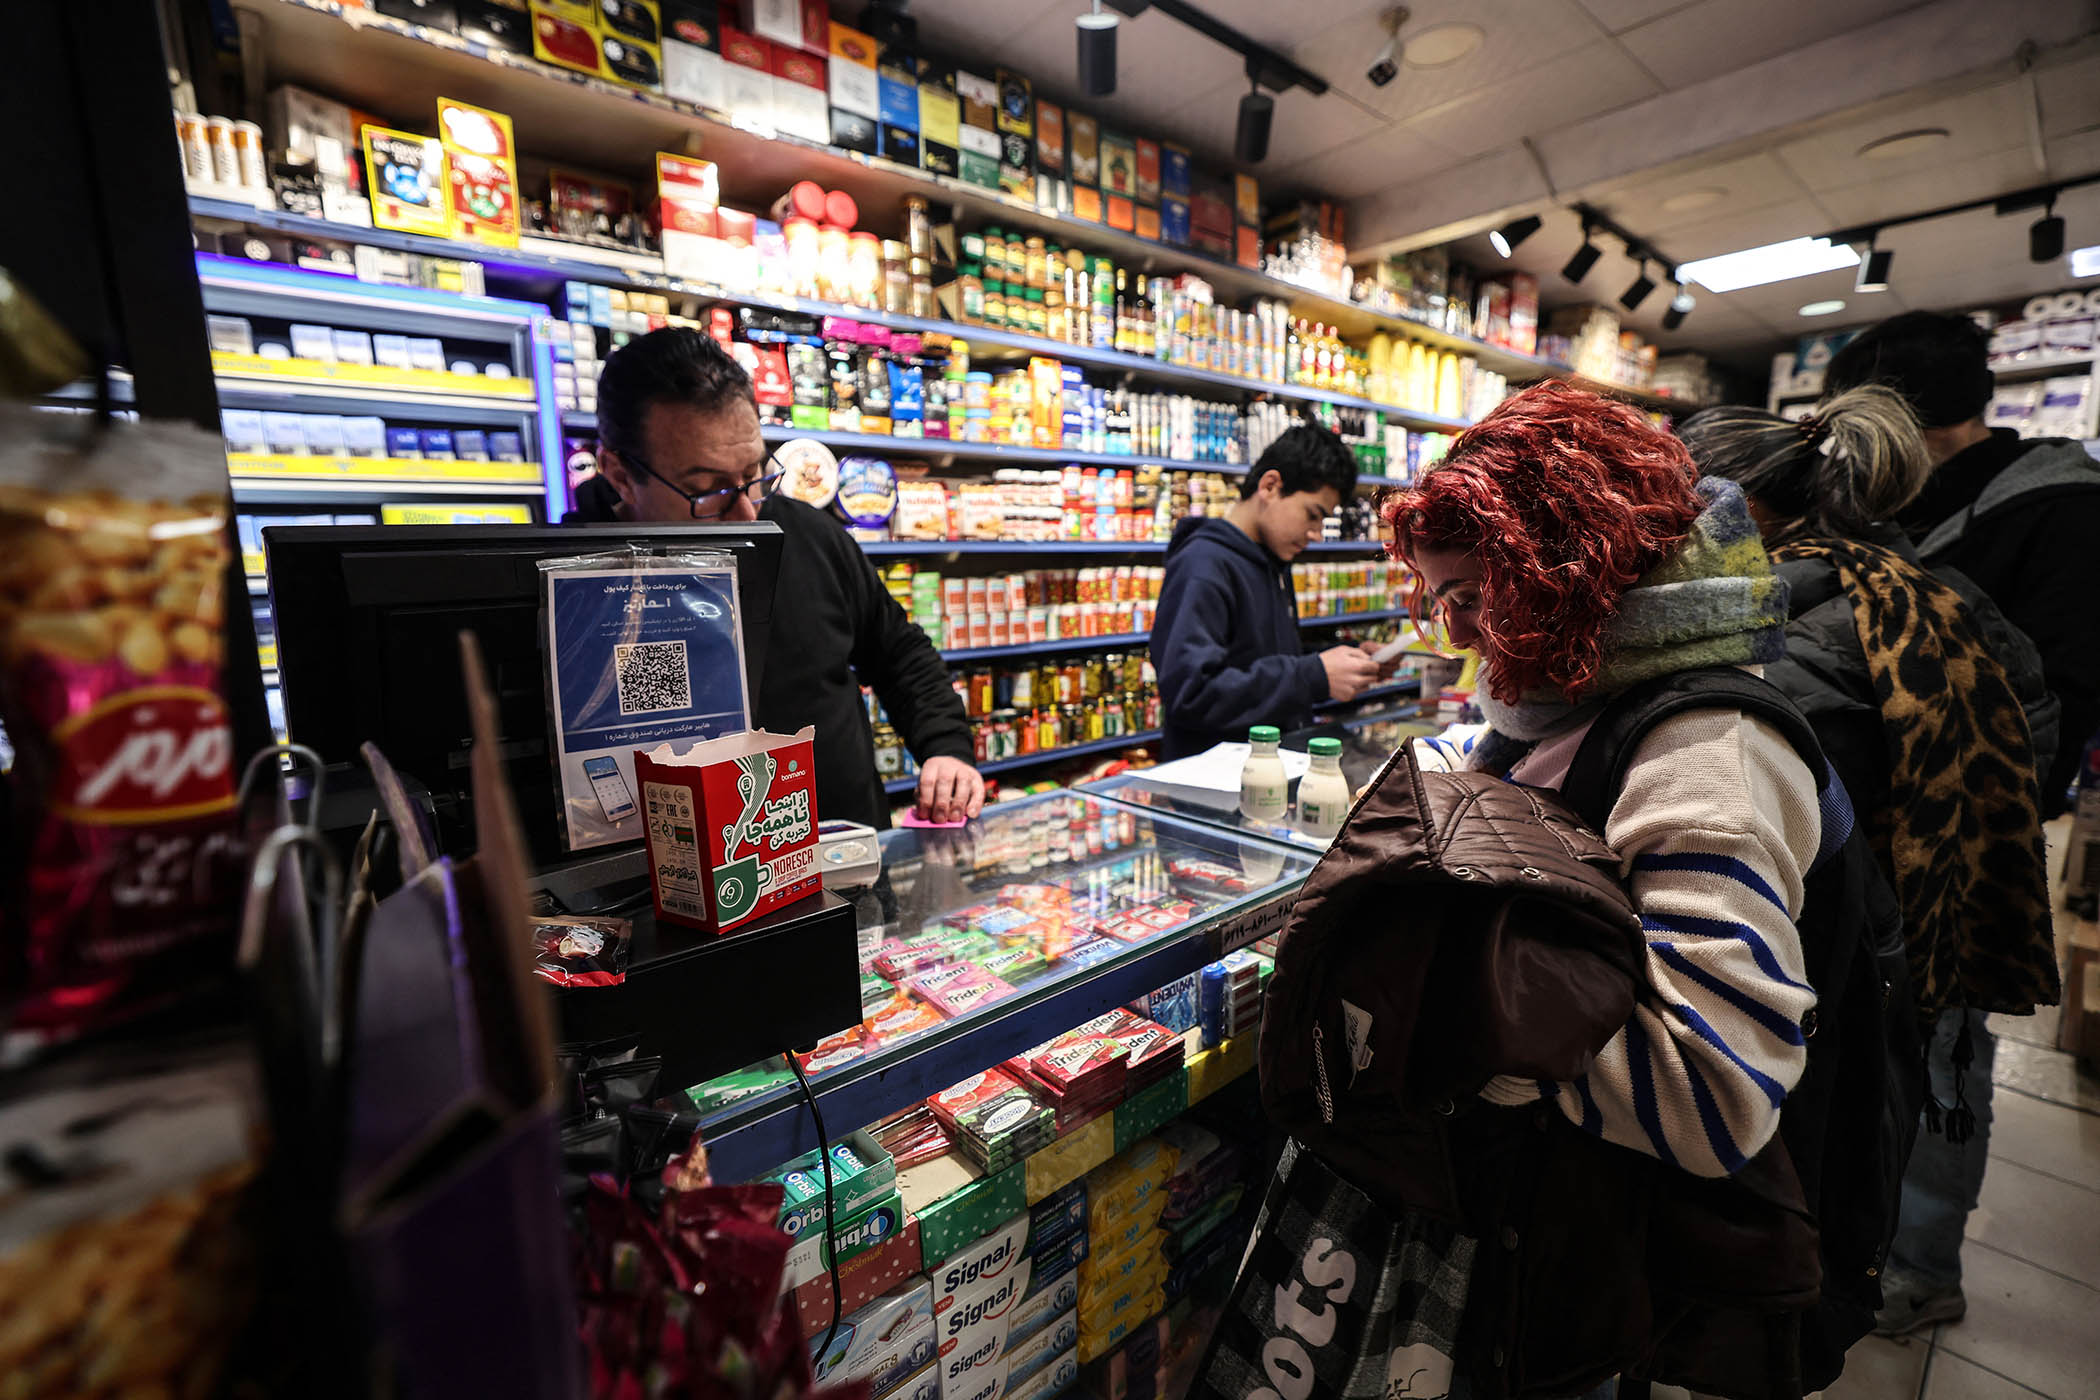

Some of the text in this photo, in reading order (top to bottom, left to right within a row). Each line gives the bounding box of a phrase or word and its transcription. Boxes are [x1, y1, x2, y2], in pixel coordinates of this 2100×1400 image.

[603, 585, 616, 594] پول
[653, 584, 674, 594] پرداخت
[674, 583, 687, 592] برای
[609, 732, 629, 742] شماره
[630, 729, 653, 740] صندوق
[674, 724, 693, 733] مارکت
[766, 791, 808, 814] از اینجا
[771, 823, 810, 847] تجربه کن
[773, 848, 814, 877] NORESCA
[984, 950, 1025, 970] Trident
[920, 966, 967, 987] Trident
[944, 982, 996, 1005] Trident
[1128, 1029, 1159, 1048] dent
[1051, 1039, 1104, 1068] Trident
[837, 1146, 865, 1172] Orbit
[787, 1172, 816, 1197] Orbit
[944, 1236, 1012, 1293] Signal
[948, 1277, 1015, 1336] Signal
[1246, 1238, 1356, 1400] ots
[949, 1336, 996, 1379] Signal
